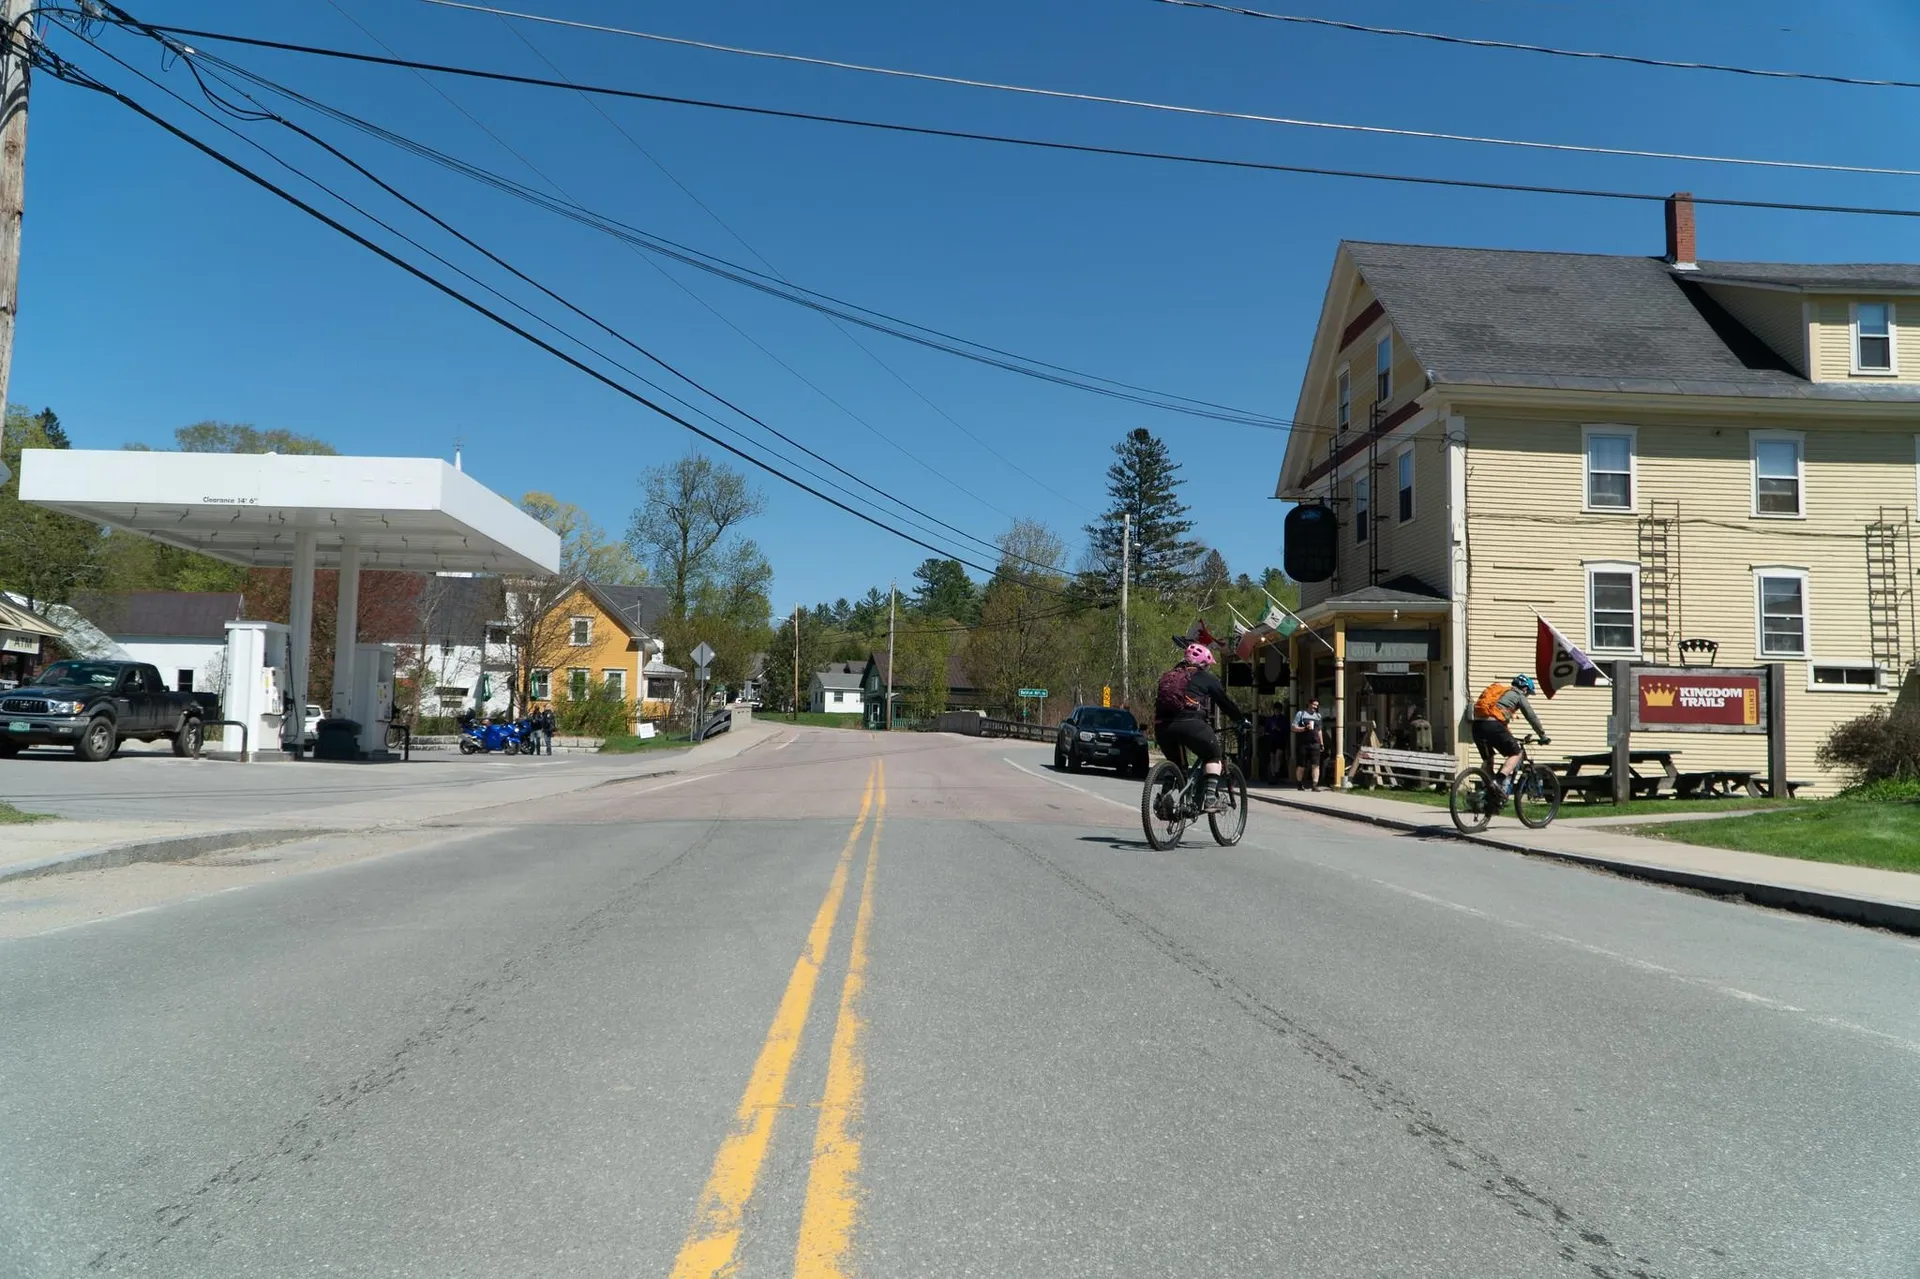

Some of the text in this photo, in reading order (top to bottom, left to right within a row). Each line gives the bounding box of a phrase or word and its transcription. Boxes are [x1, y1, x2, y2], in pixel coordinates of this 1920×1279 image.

[203, 496, 235, 504] Clearance
[14, 636, 32, 648] ATM
[1679, 687, 1743, 698] KINGDOM
[1679, 697, 1725, 708] TRAILS
